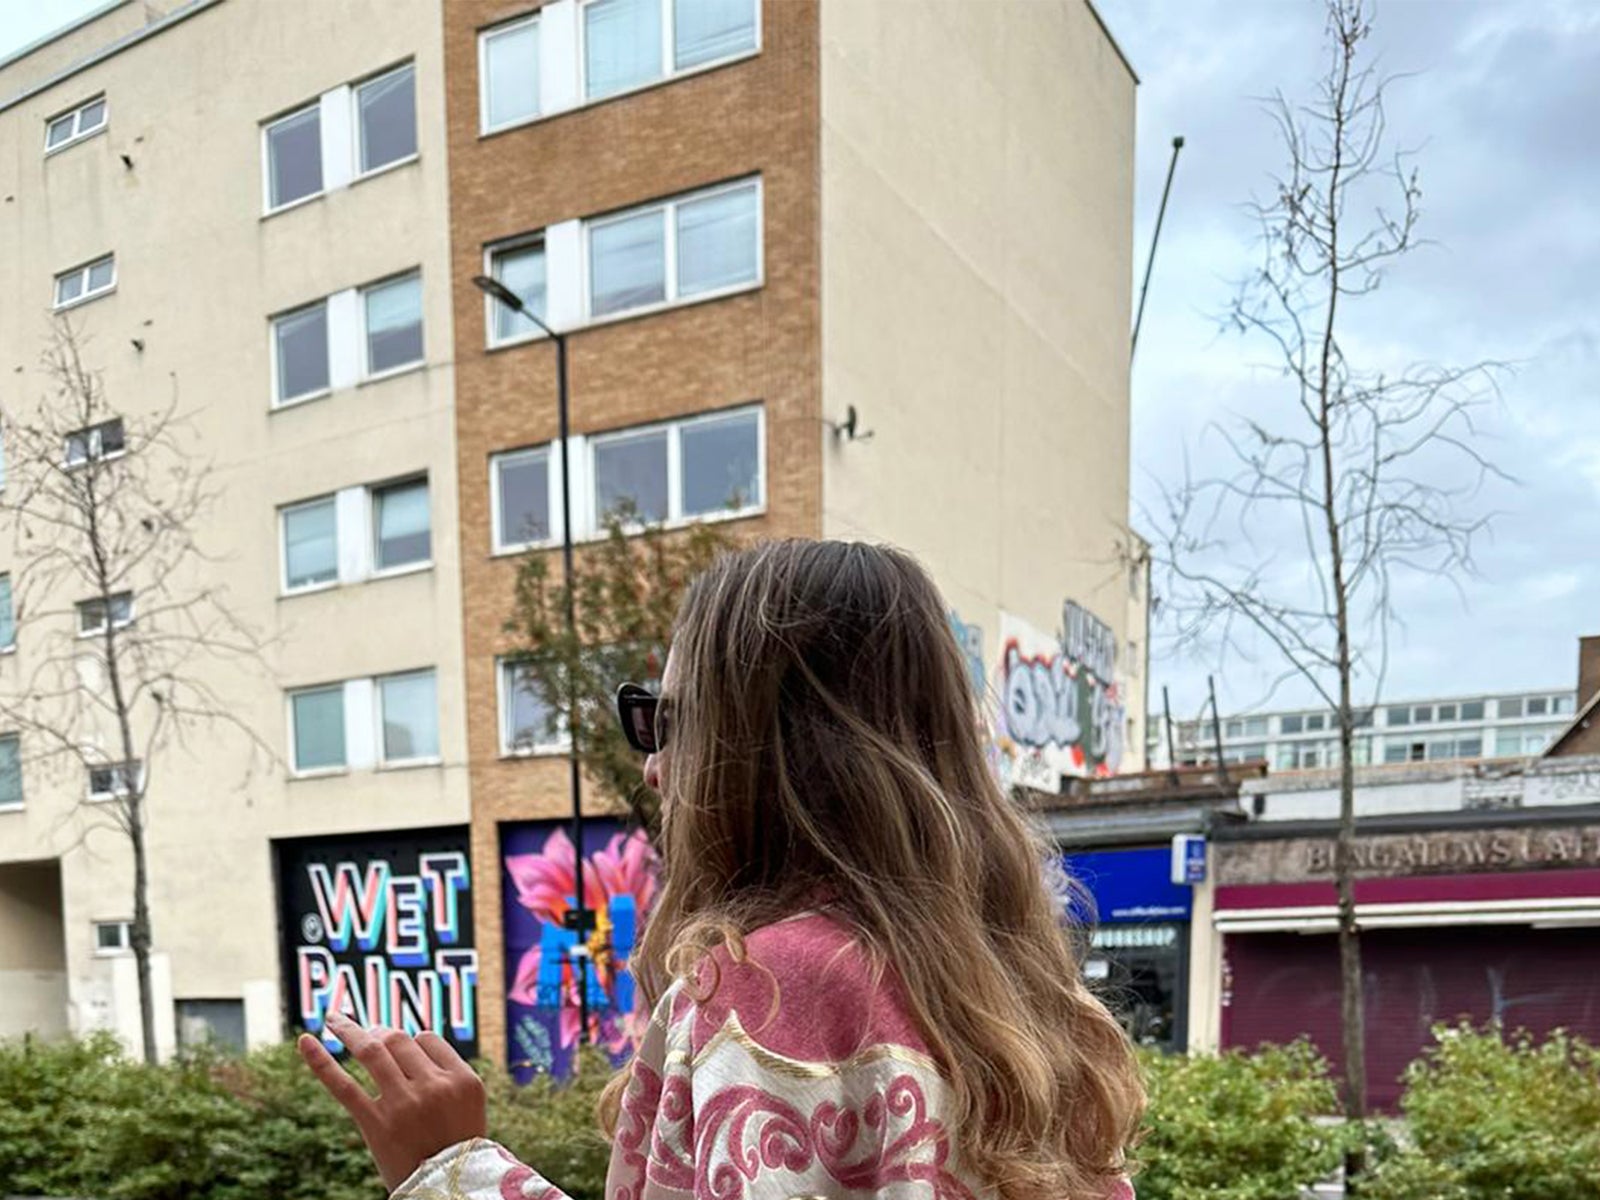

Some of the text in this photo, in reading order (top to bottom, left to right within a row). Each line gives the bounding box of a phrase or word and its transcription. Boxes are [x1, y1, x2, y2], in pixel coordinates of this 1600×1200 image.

[1519, 829, 1600, 863] CAF
[307, 851, 470, 967] WET
[297, 946, 478, 1054] PAINT
